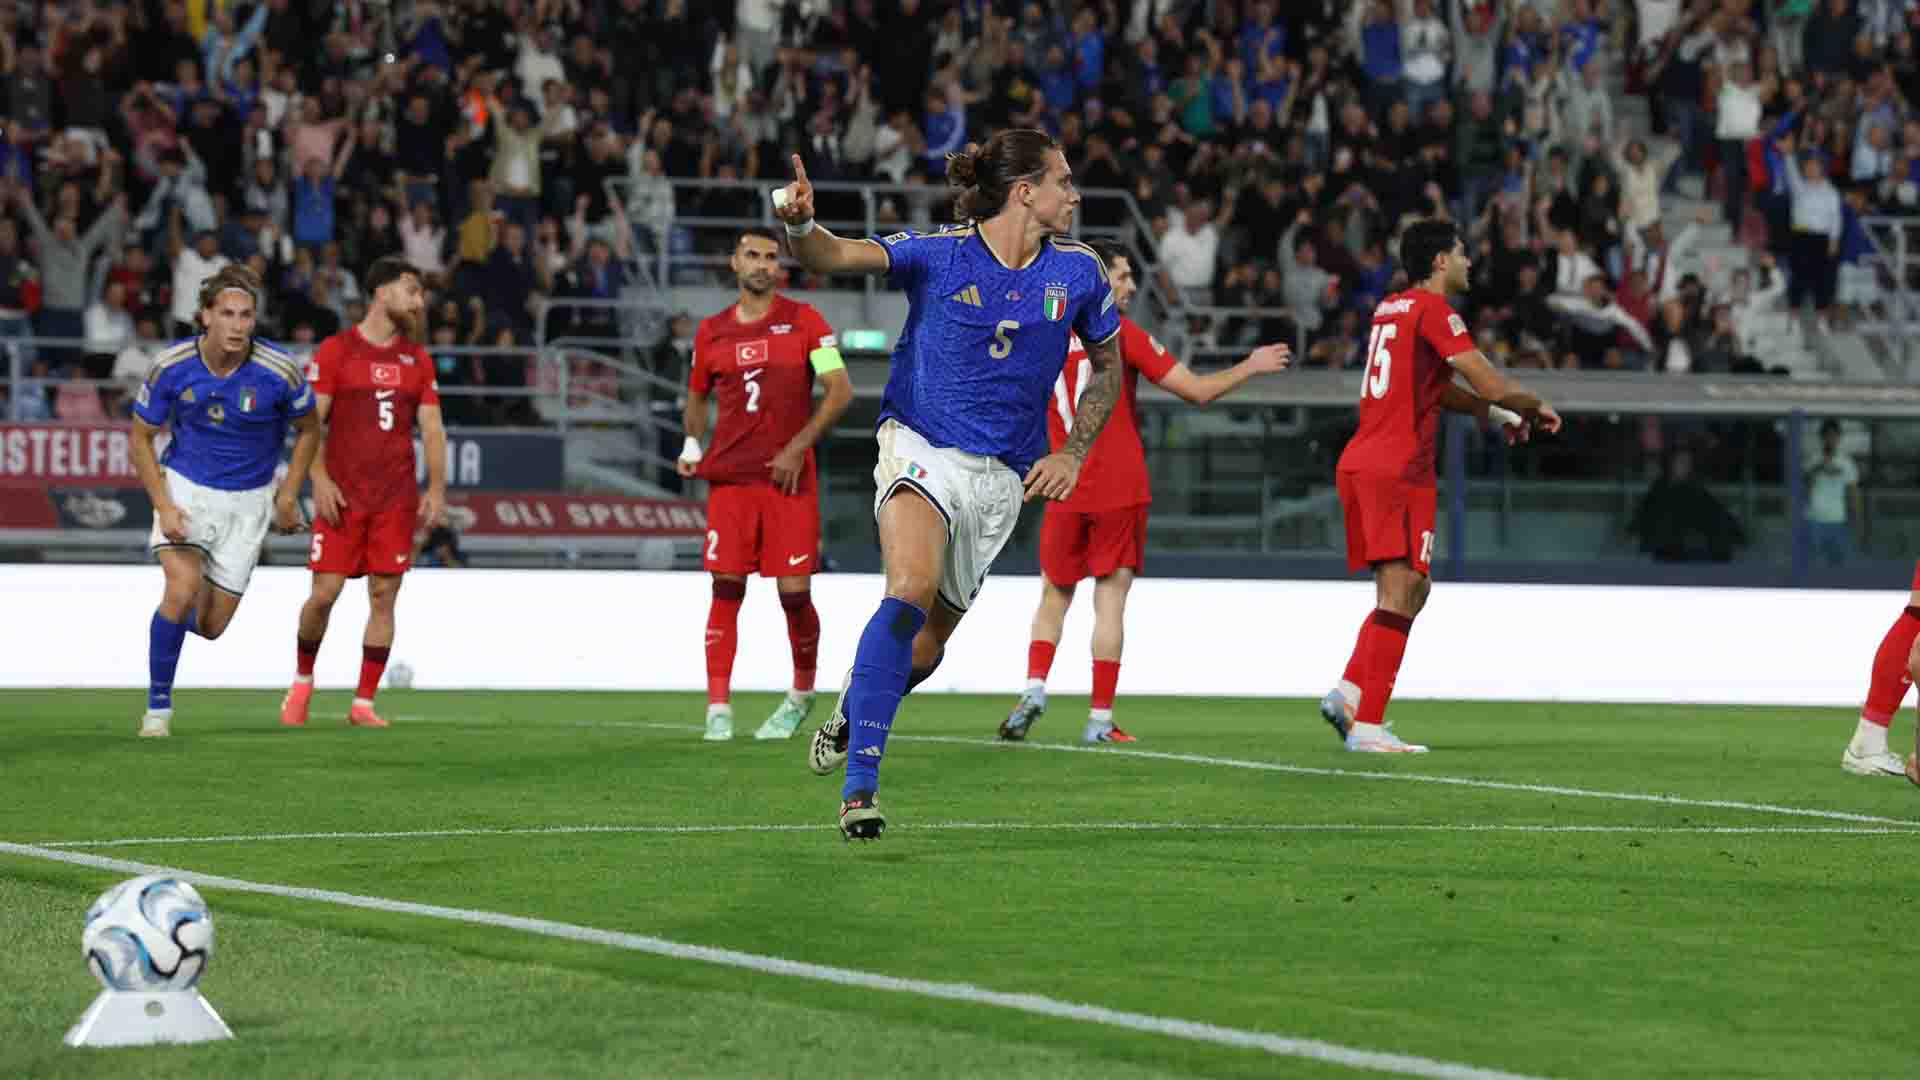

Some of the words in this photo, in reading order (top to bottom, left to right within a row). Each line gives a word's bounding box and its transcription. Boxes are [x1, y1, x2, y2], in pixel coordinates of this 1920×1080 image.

[989, 320, 1020, 359] 5
[1361, 324, 1397, 399] 15
[745, 381, 760, 412] 2
[379, 401, 395, 431] 5
[311, 533, 324, 562] 5
[707, 529, 719, 561] 2
